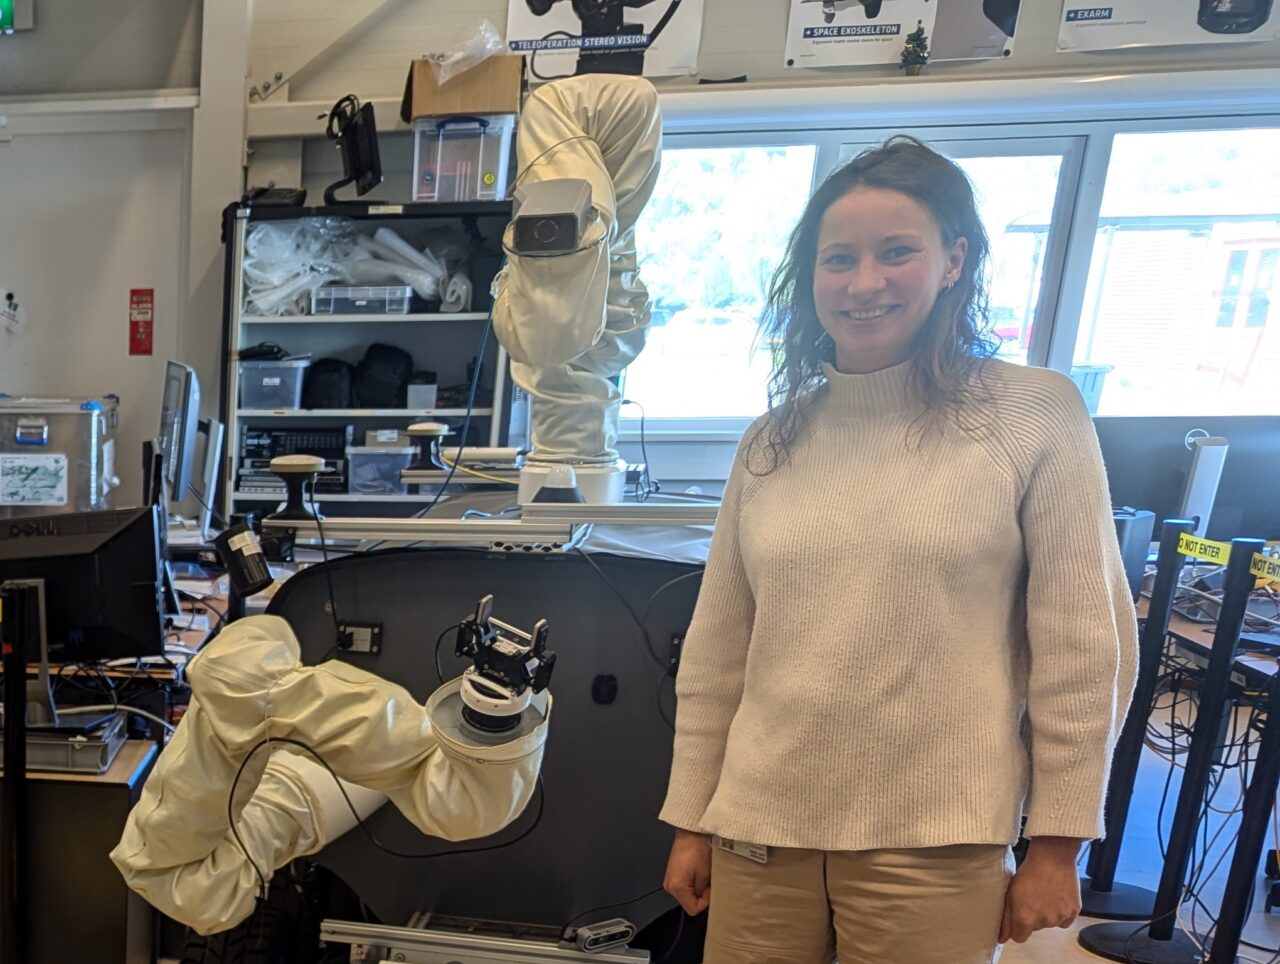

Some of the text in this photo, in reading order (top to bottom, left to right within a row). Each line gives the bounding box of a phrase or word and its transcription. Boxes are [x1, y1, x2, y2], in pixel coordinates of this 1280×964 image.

[1077, 9, 1109, 19] EXARM
[813, 25, 898, 37] SPACE EXOSKELETON
[517, 34, 648, 50] TELEOPERATION STEREO VISION
[1185, 538, 1198, 554] NOT
[1198, 543, 1221, 560] ENTER
[1251, 556, 1280, 579] NOT ENT
